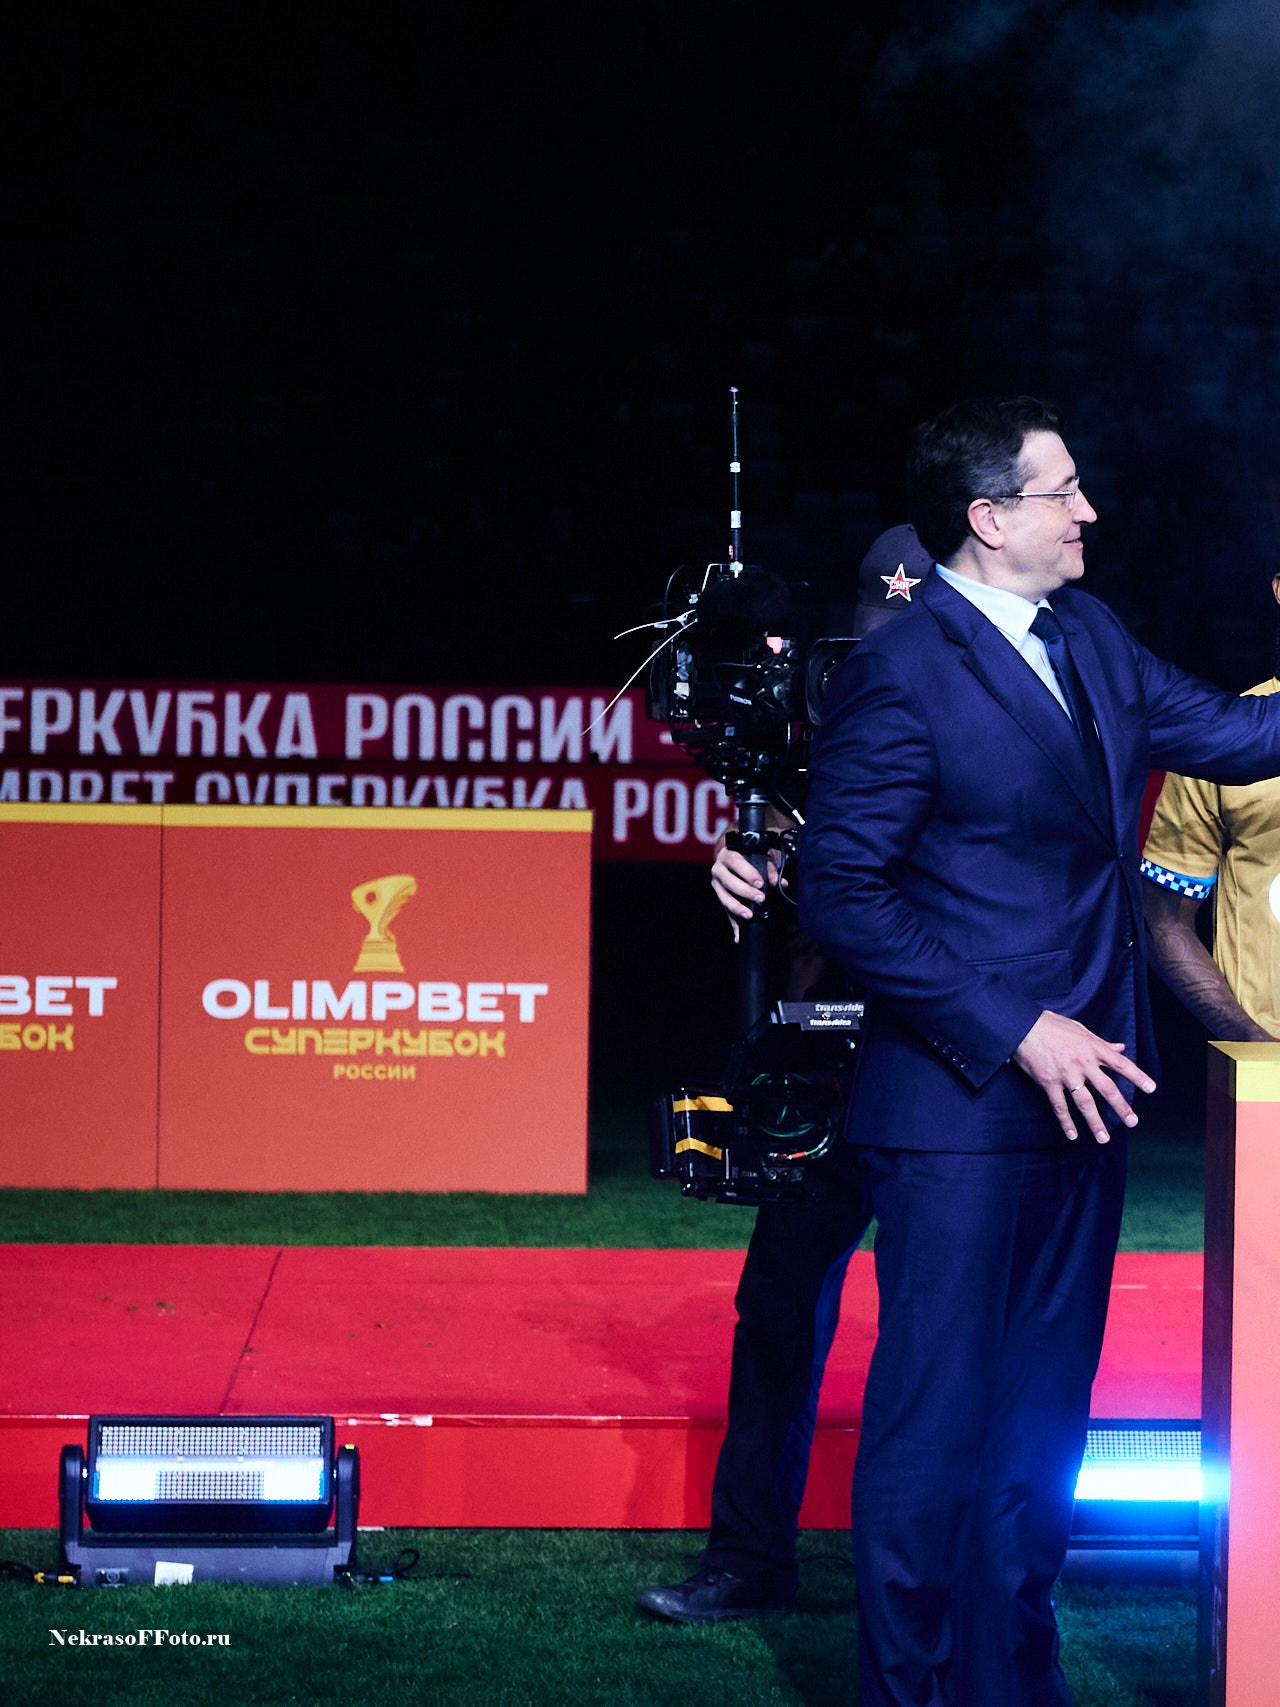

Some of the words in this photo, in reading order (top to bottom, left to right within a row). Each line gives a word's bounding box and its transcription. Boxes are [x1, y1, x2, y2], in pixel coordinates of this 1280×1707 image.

[345, 693, 633, 763] РОССИИ
[202, 978, 549, 1023] OLIMPBET
[244, 1026, 506, 1057] СУПЕРКУБОК
[333, 1063, 416, 1081] РОССИИ
